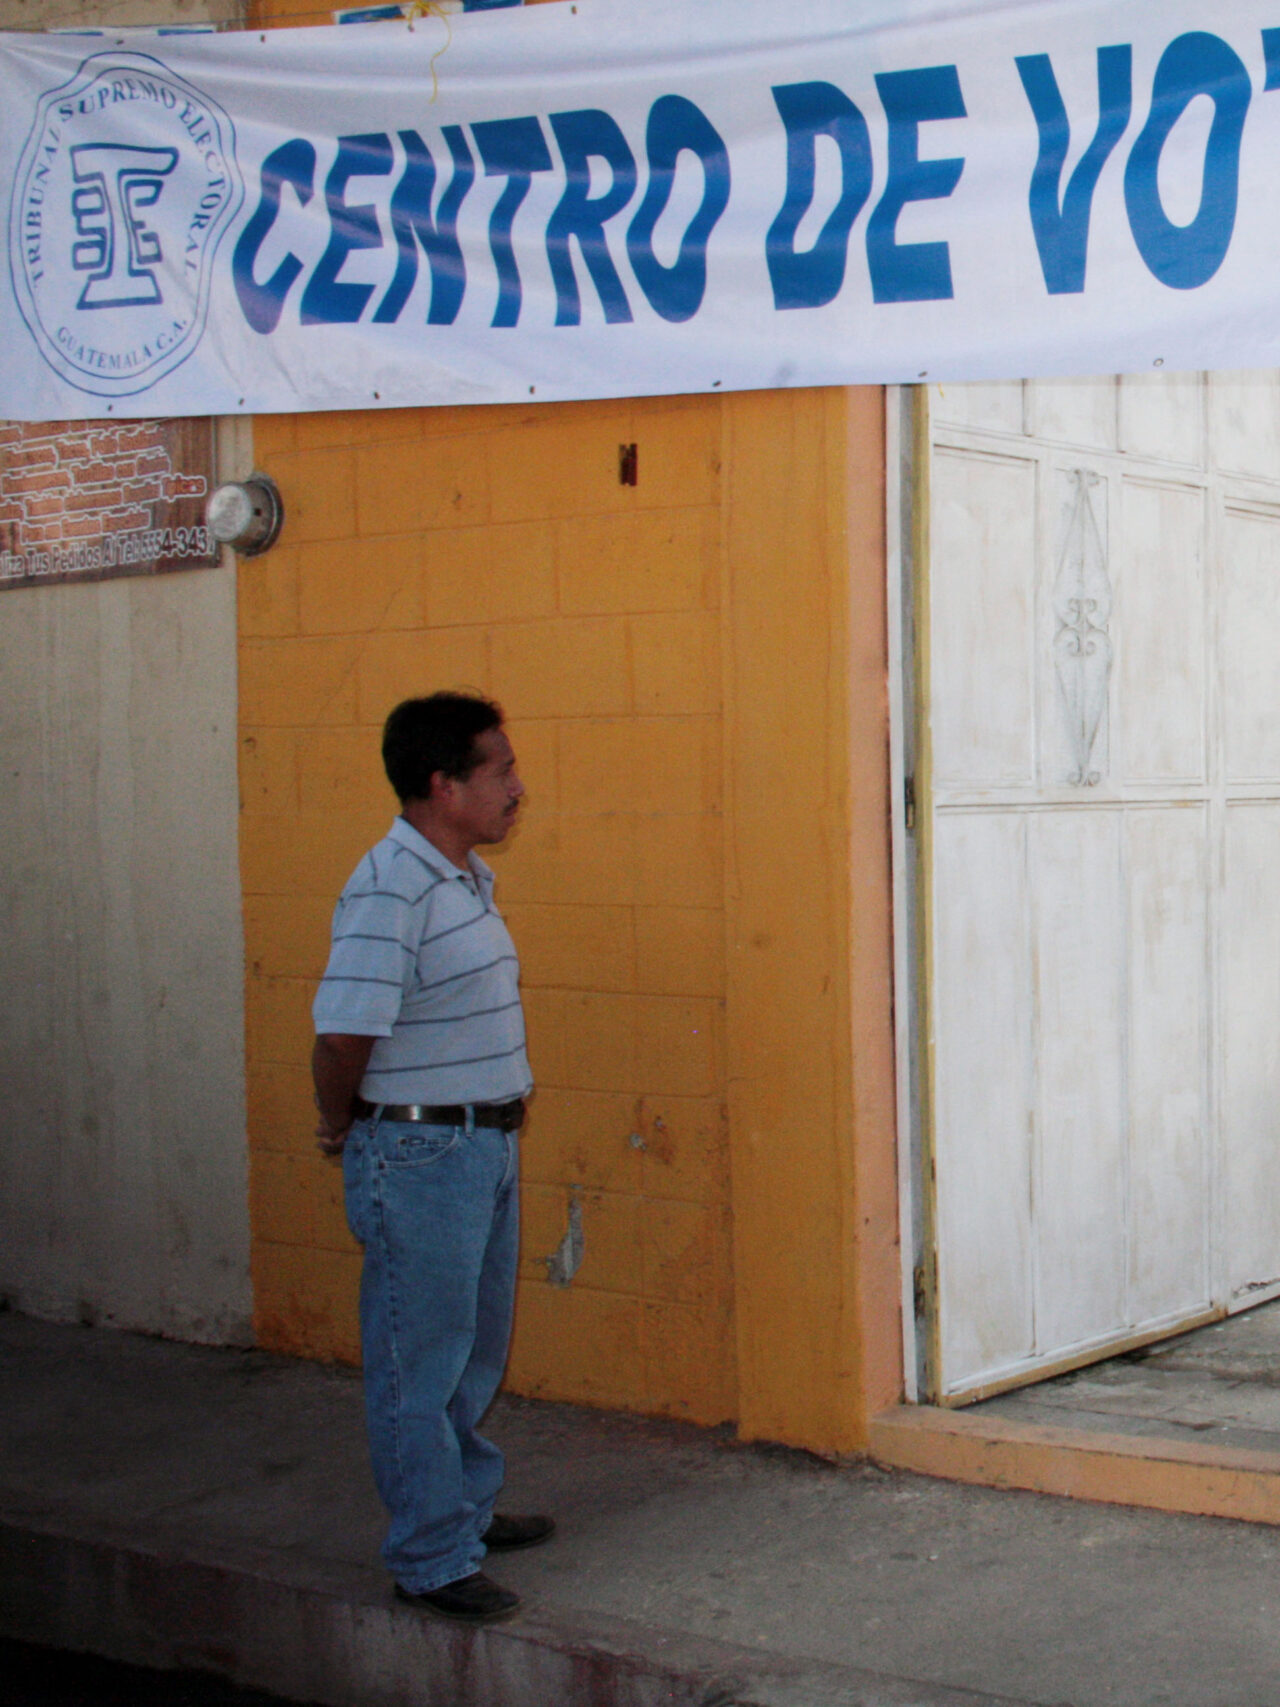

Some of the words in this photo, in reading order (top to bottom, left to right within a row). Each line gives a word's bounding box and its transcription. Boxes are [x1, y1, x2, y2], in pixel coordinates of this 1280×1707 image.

[26, 128, 61, 288] TRIBUNAL
[58, 78, 176, 122] SUPREMO
[178, 100, 226, 271] ELECTORAL
[232, 94, 731, 335] CENTRO
[765, 64, 968, 311] DE
[57, 326, 152, 370] GUATEMALA
[156, 317, 188, 350] C.A.
[27, 547, 51, 576] Tus
[52, 542, 101, 572] Pedidos
